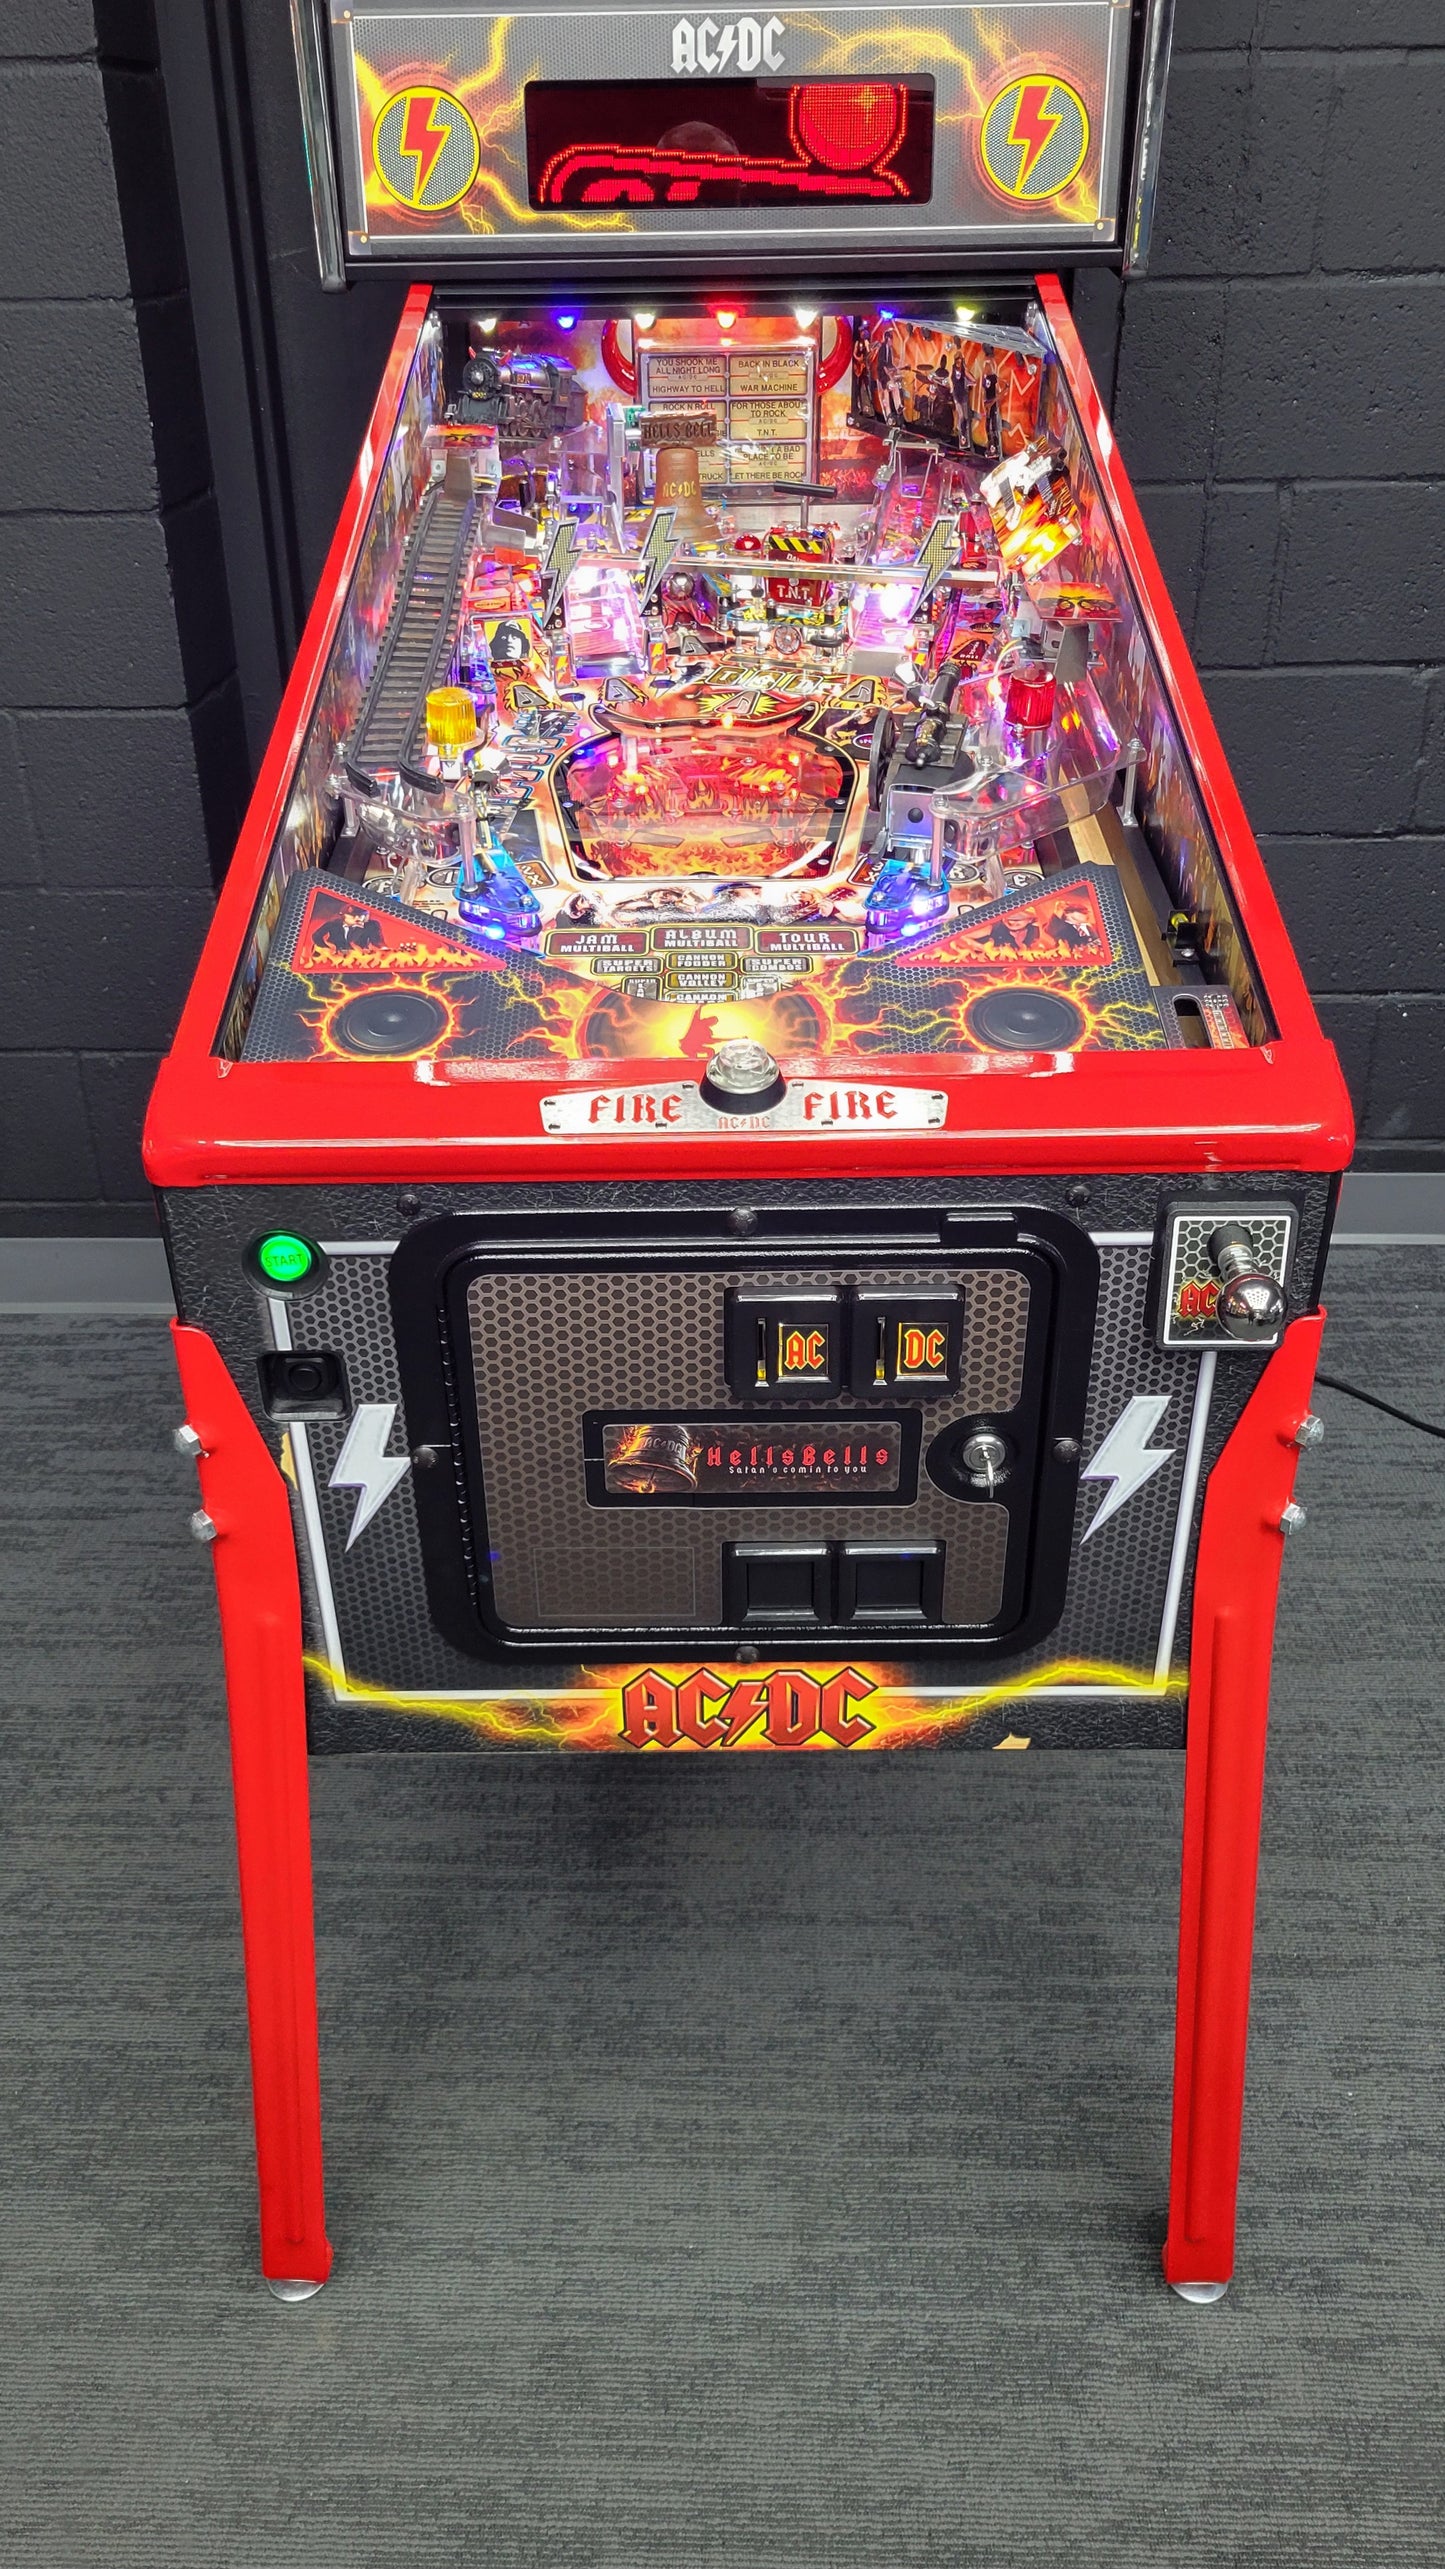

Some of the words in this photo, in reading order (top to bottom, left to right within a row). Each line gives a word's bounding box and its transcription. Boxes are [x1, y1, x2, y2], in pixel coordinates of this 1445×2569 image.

[656, 358, 674, 366] YOU
[675, 358, 703, 366] SHOOK
[706, 357, 718, 365] ME
[738, 360, 760, 368] BACK
[762, 360, 771, 368] IN
[773, 359, 800, 368] BLACK
[655, 366, 671, 374] ALL
[672, 366, 696, 374] NIGHT
[697, 366, 721, 374] LONG
[652, 385, 690, 393] HIGHWAY
[691, 385, 702, 393] TO
[704, 384, 725, 392] HELL
[740, 384, 759, 392] WAR
[761, 383, 798, 392] MACHINE
[662, 402, 685, 410] ROCK
[695, 402, 716, 410] ROLL
[731, 402, 749, 410] FOR
[750, 401, 777, 409] THOSE
[750, 410, 761, 418] TO
[763, 410, 786, 418] ROCK
[784, 445, 801, 453] BAD
[746, 472, 771, 480] THERE
[776, 584, 813, 600] T.N.T.
[664, 928, 738, 940] ALBUM
[779, 932, 831, 943] TOUR
[575, 934, 618, 945] JAM
[664, 939, 738, 948] MULTIBALL
[560, 944, 635, 953] MULTIBALL
[769, 943, 846, 952] MULTIBALL
[602, 965, 654, 973] TARGETS
[587, 1093, 684, 1124] FIRE
[802, 1090, 898, 1121] FIRE
[264, 1253, 304, 1268] START
[784, 1330, 827, 1371] AC
[903, 1328, 946, 1369] DC
[782, 1465, 822, 1474] comin
[827, 1465, 839, 1474] to
[844, 1465, 867, 1475] you
